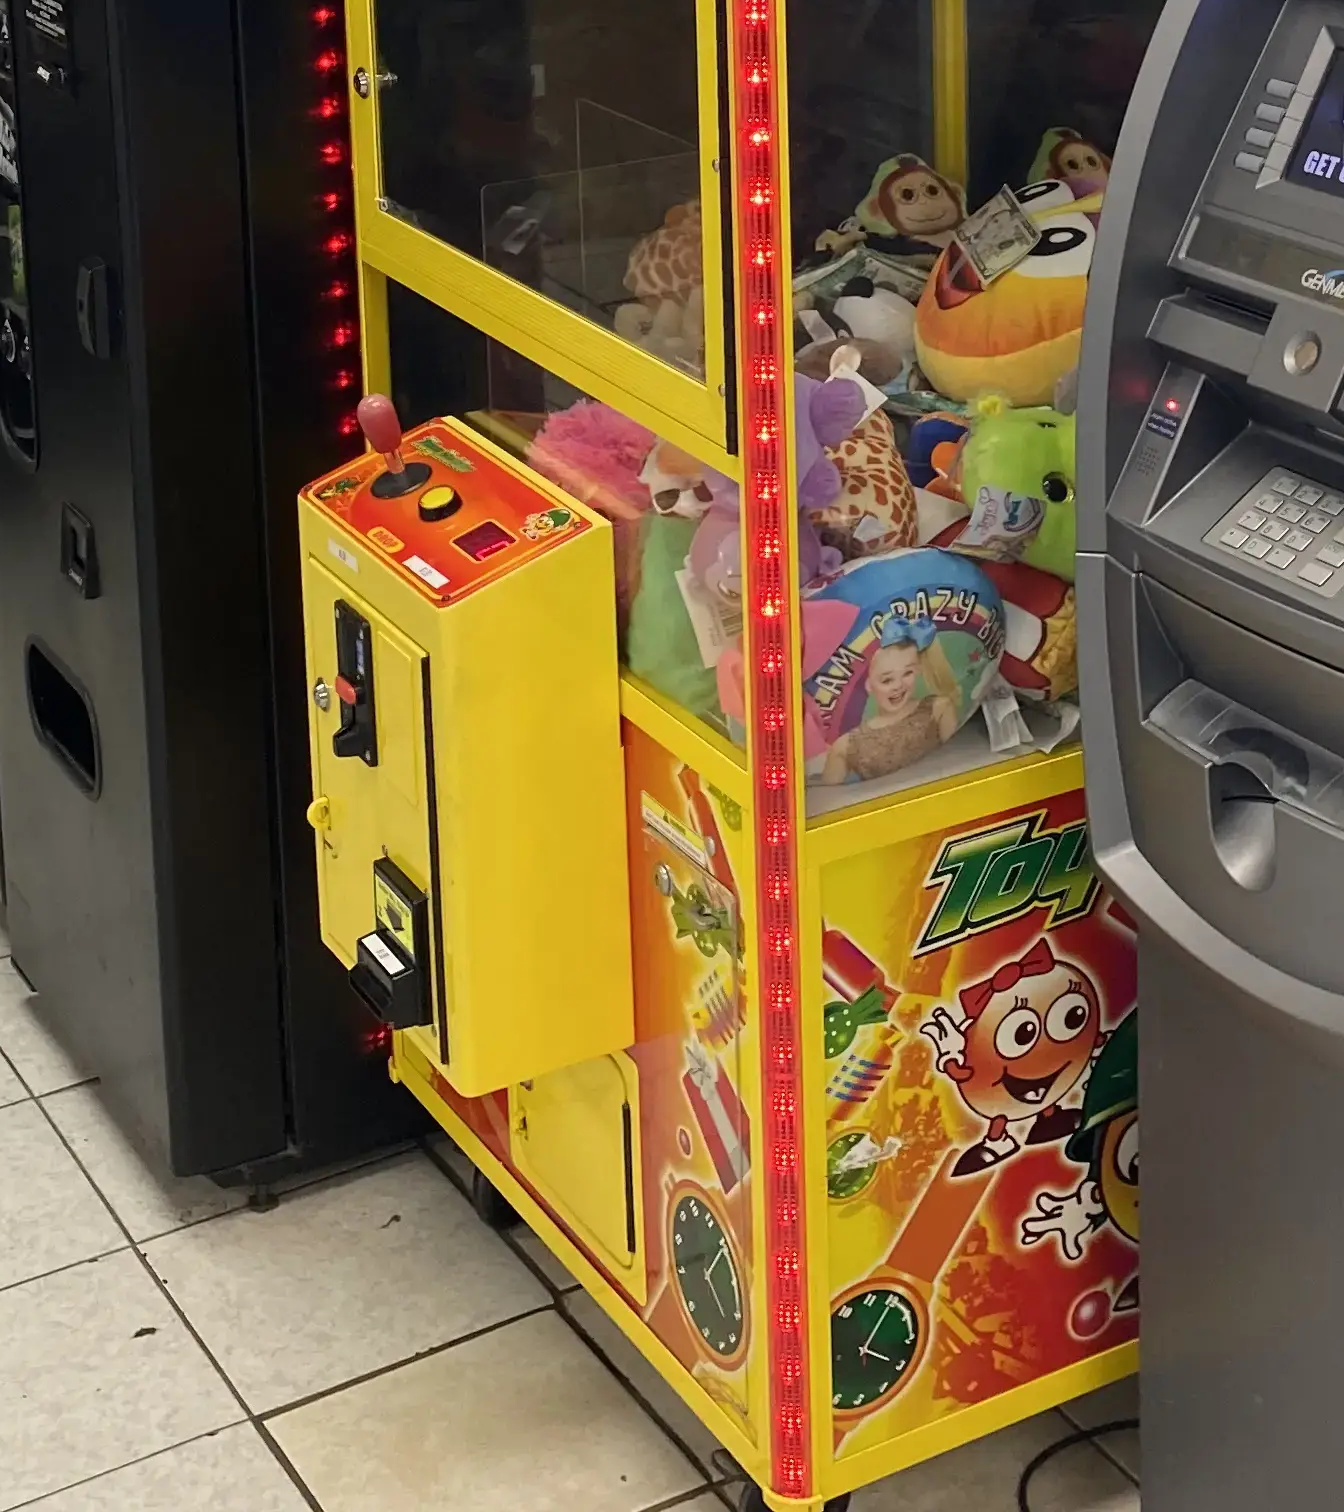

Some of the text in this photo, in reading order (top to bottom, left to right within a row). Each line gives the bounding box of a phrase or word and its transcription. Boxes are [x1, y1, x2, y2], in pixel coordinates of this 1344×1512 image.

[1303, 150, 1341, 180] GET
[870, 587, 978, 641] CRAZY
[918, 813, 1100, 954] Toy
